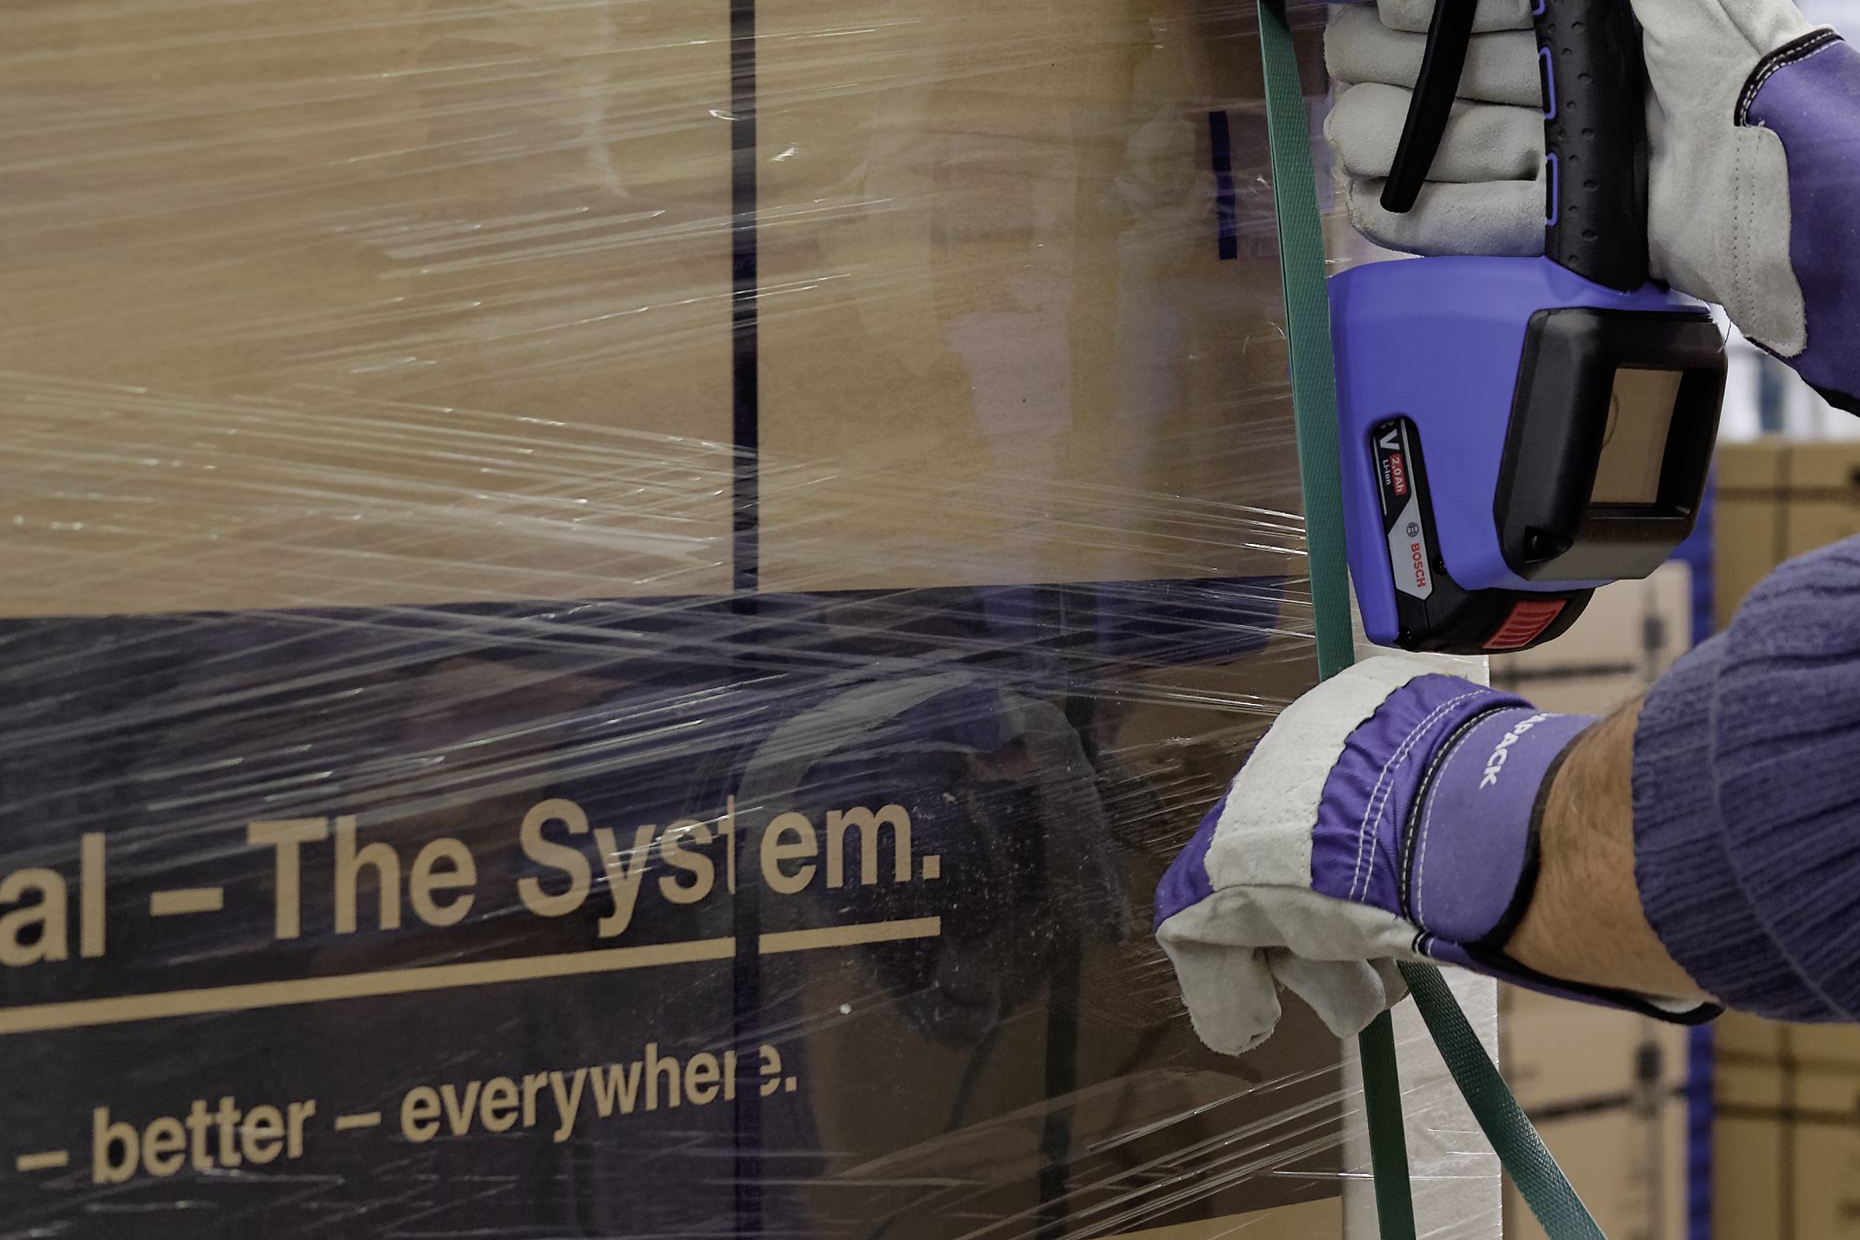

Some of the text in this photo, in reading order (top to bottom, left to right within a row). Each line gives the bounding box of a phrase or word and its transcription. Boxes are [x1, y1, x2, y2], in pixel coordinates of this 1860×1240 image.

[1410, 542, 1427, 589] BOSCH
[246, 814, 477, 940] The
[93, 1095, 317, 1185] better
